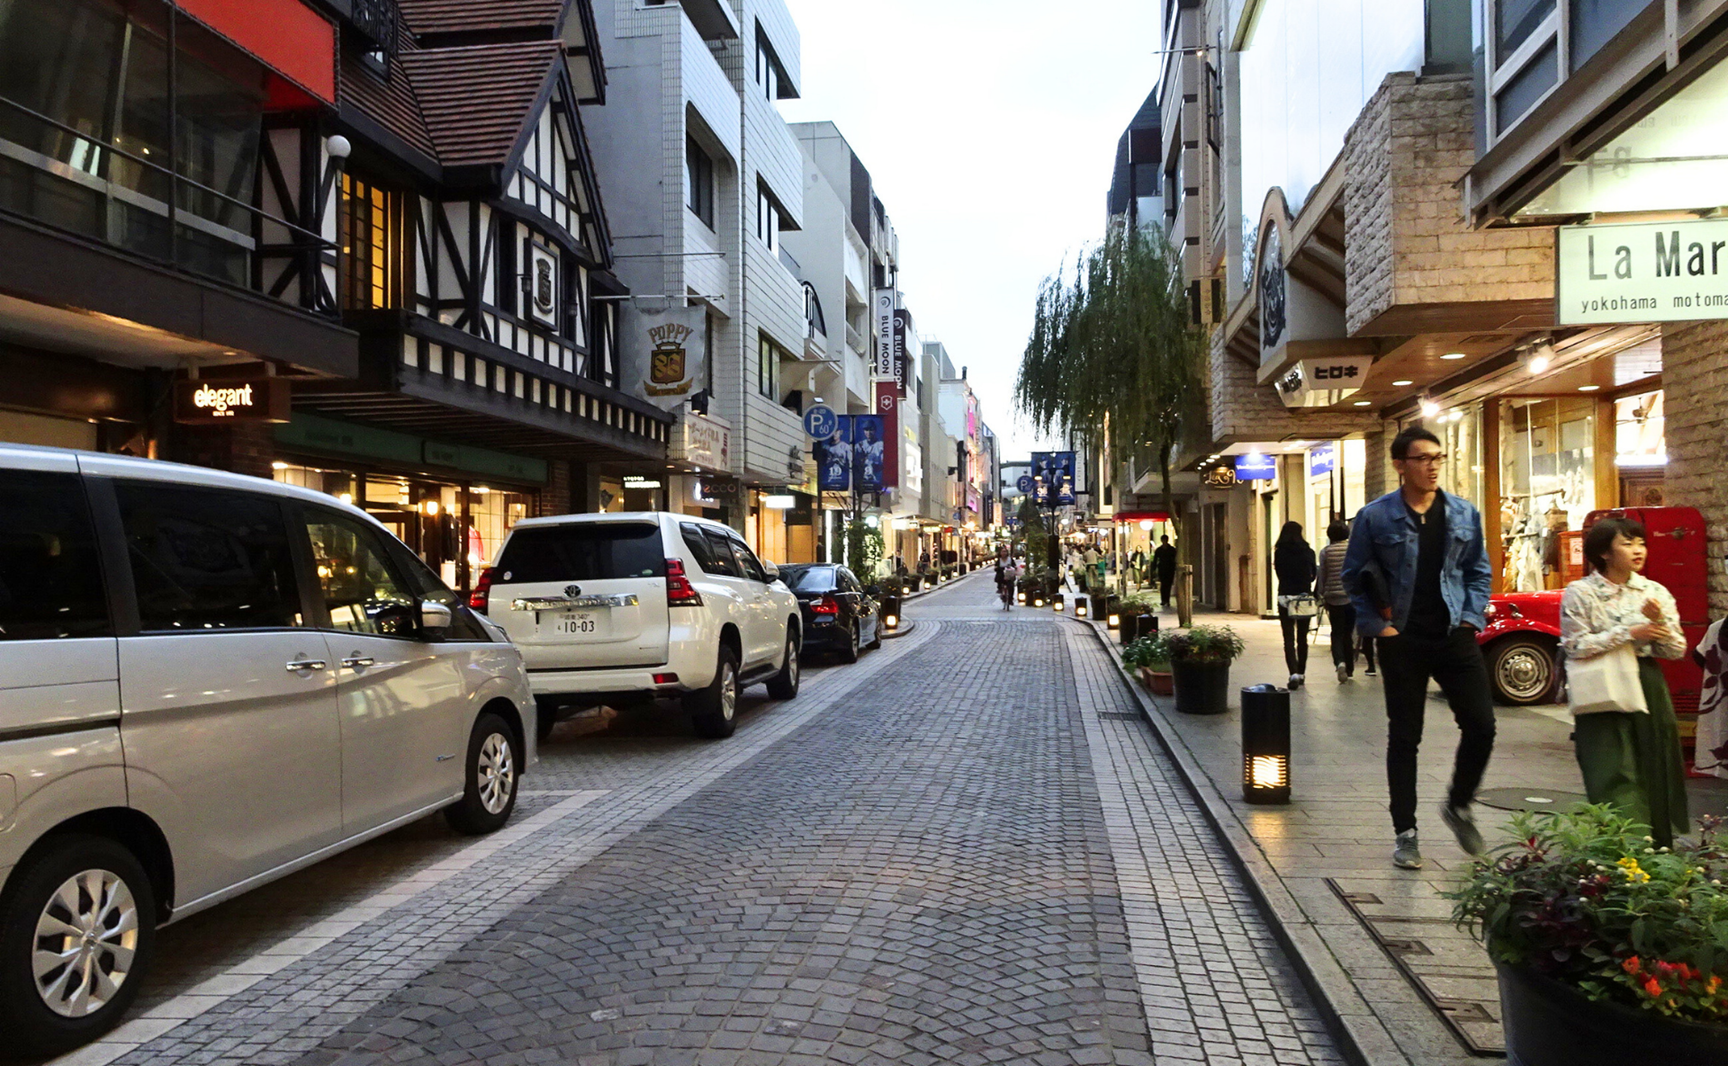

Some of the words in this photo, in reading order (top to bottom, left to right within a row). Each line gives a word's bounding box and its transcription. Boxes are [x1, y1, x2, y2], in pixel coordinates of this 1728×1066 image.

[1588, 234, 1632, 280] La
[1655, 230, 1726, 277] Mar
[1581, 295, 1658, 314] yokohama
[647, 323, 695, 343] POPPY
[881, 315, 889, 339] BLUE
[894, 334, 902, 357] BLUE
[881, 342, 890, 374] MOON
[894, 360, 903, 390] MOON
[1314, 365, 1359, 379] ヒロキ
[194, 383, 253, 411] elegant
[810, 414, 824, 435] P
[703, 483, 736, 493] ecco
[564, 620, 595, 633] 10-03
